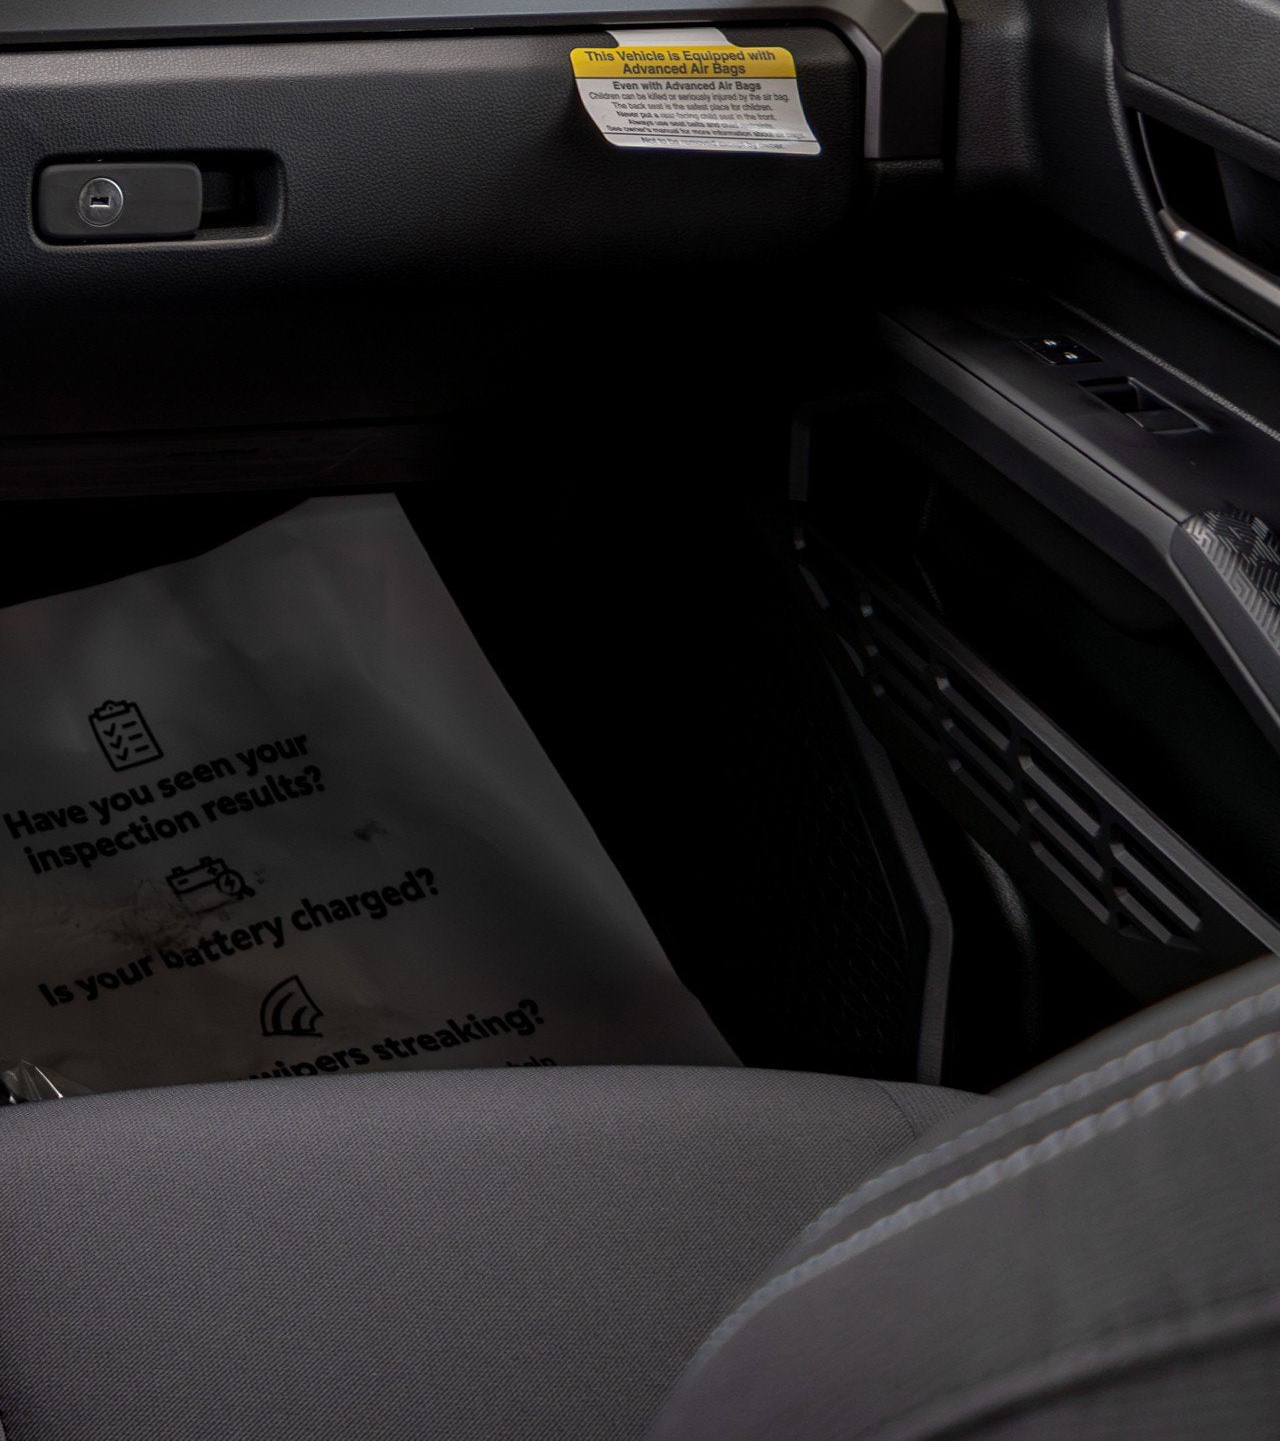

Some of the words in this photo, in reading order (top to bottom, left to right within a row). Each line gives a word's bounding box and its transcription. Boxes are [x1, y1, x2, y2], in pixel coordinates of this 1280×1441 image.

[585, 51, 614, 61] This
[617, 51, 664, 61] Vehicle
[668, 51, 679, 61] is
[683, 50, 745, 65] Equipped
[747, 50, 776, 60] with
[613, 82, 638, 90] Even
[641, 81, 663, 90] with
[665, 81, 716, 90] Advanced
[718, 81, 733, 90] Air
[735, 81, 761, 92] Bags
[623, 63, 687, 74] Advanced
[691, 63, 710, 74] Air
[714, 63, 746, 76] Bags
[3, 800, 89, 841] Have
[89, 782, 155, 825] you
[156, 755, 237, 799] seen
[238, 734, 309, 776] your
[23, 808, 201, 877] inspection
[202, 764, 326, 823] results?
[39, 982, 75, 1008] Is
[74, 954, 155, 1001] your
[156, 915, 285, 971] battery
[290, 867, 440, 934] charged?
[371, 998, 546, 1059] streaking?
